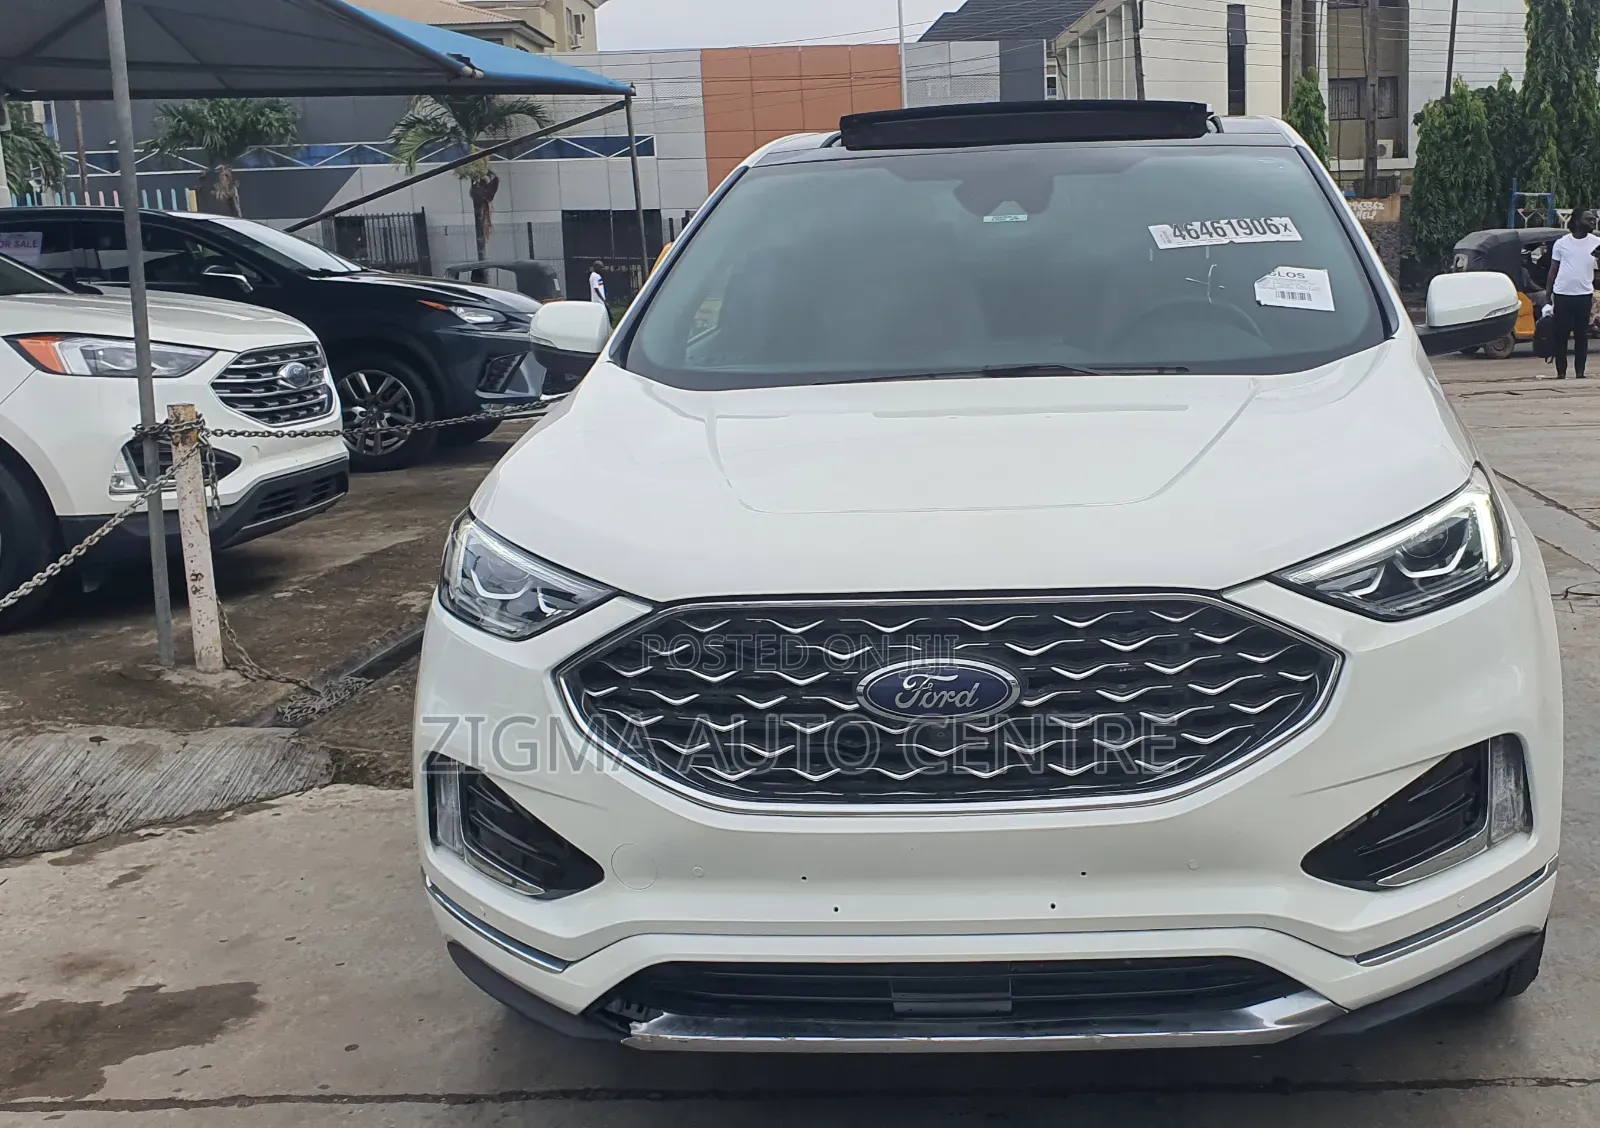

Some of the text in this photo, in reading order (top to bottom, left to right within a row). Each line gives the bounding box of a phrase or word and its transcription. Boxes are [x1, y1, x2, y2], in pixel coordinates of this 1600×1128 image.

[1357, 210, 1377, 220] HELP
[14, 239, 38, 248] SALE
[895, 673, 980, 709] Ford
